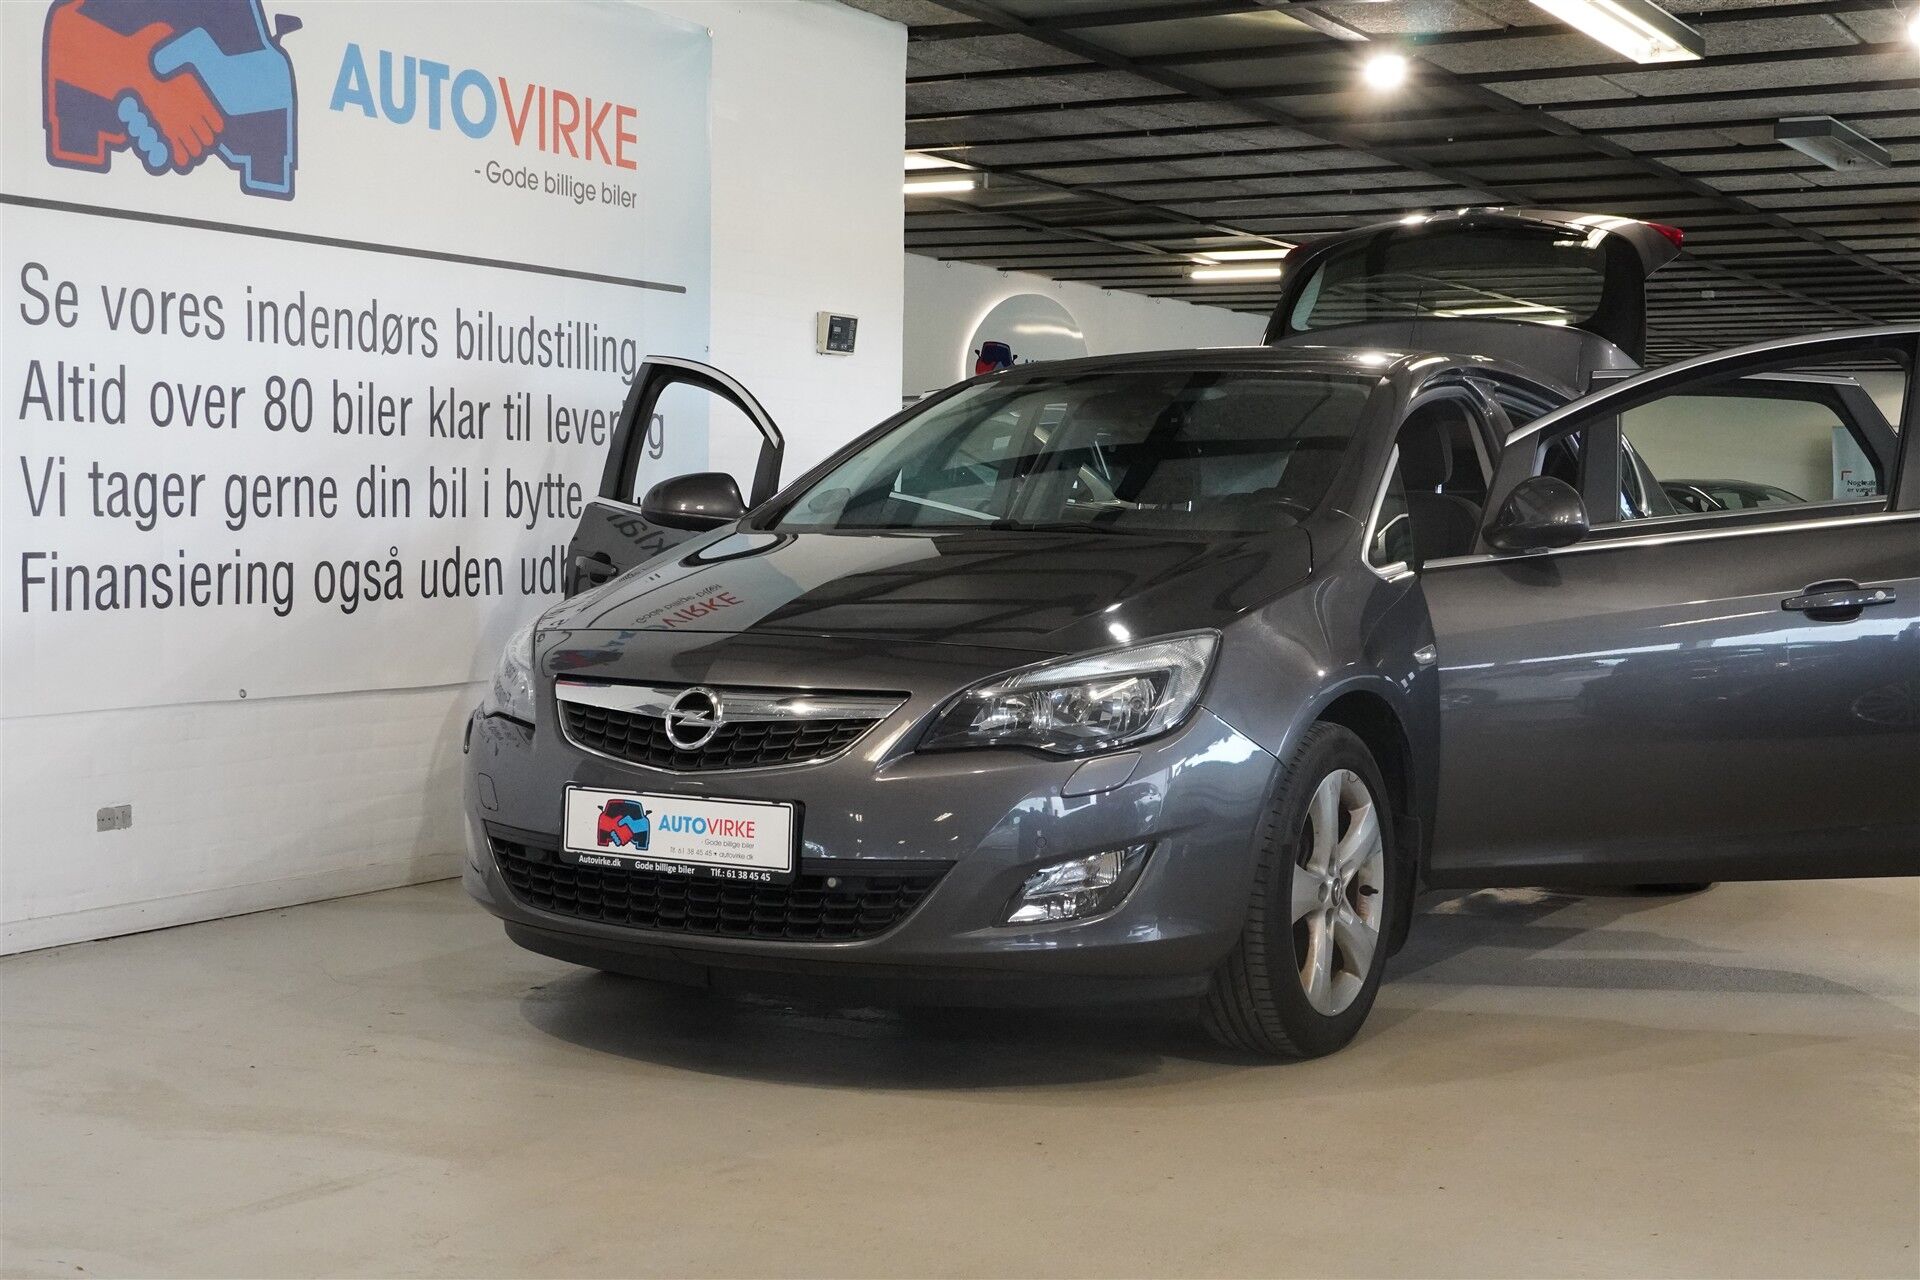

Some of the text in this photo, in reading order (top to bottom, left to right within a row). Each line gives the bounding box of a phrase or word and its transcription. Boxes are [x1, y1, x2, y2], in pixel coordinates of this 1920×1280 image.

[329, 43, 638, 170] AUTOVIRKE
[485, 160, 539, 192] Gode
[544, 167, 597, 205] billige
[601, 181, 637, 209] biler
[20, 262, 638, 387] Se vores indendørs biludstilling
[20, 359, 126, 426] Altid
[149, 381, 246, 438] over
[264, 374, 313, 433] 80
[333, 379, 414, 437] biler
[429, 386, 490, 441] klar
[502, 393, 531, 442] til
[20, 456, 583, 533] Vi tager gerne din bil i bytte
[22, 551, 294, 617] Finansiering
[313, 547, 404, 611] også
[420, 546, 503, 601] uden
[659, 815, 754, 838] AUTOVIRKE
[687, 848, 695, 856] 38
[695, 849, 704, 857] 45
[704, 838, 755, 850] Gode billige biler
[579, 855, 621, 867] Autovirke.dk
[634, 860, 654, 871] Gode
[655, 861, 677, 874] billige
[677, 864, 695, 875] biler
[726, 869, 737, 879] 61
[738, 870, 748, 880] 38
[749, 871, 759, 881] 45
[760, 872, 771, 882] 45
